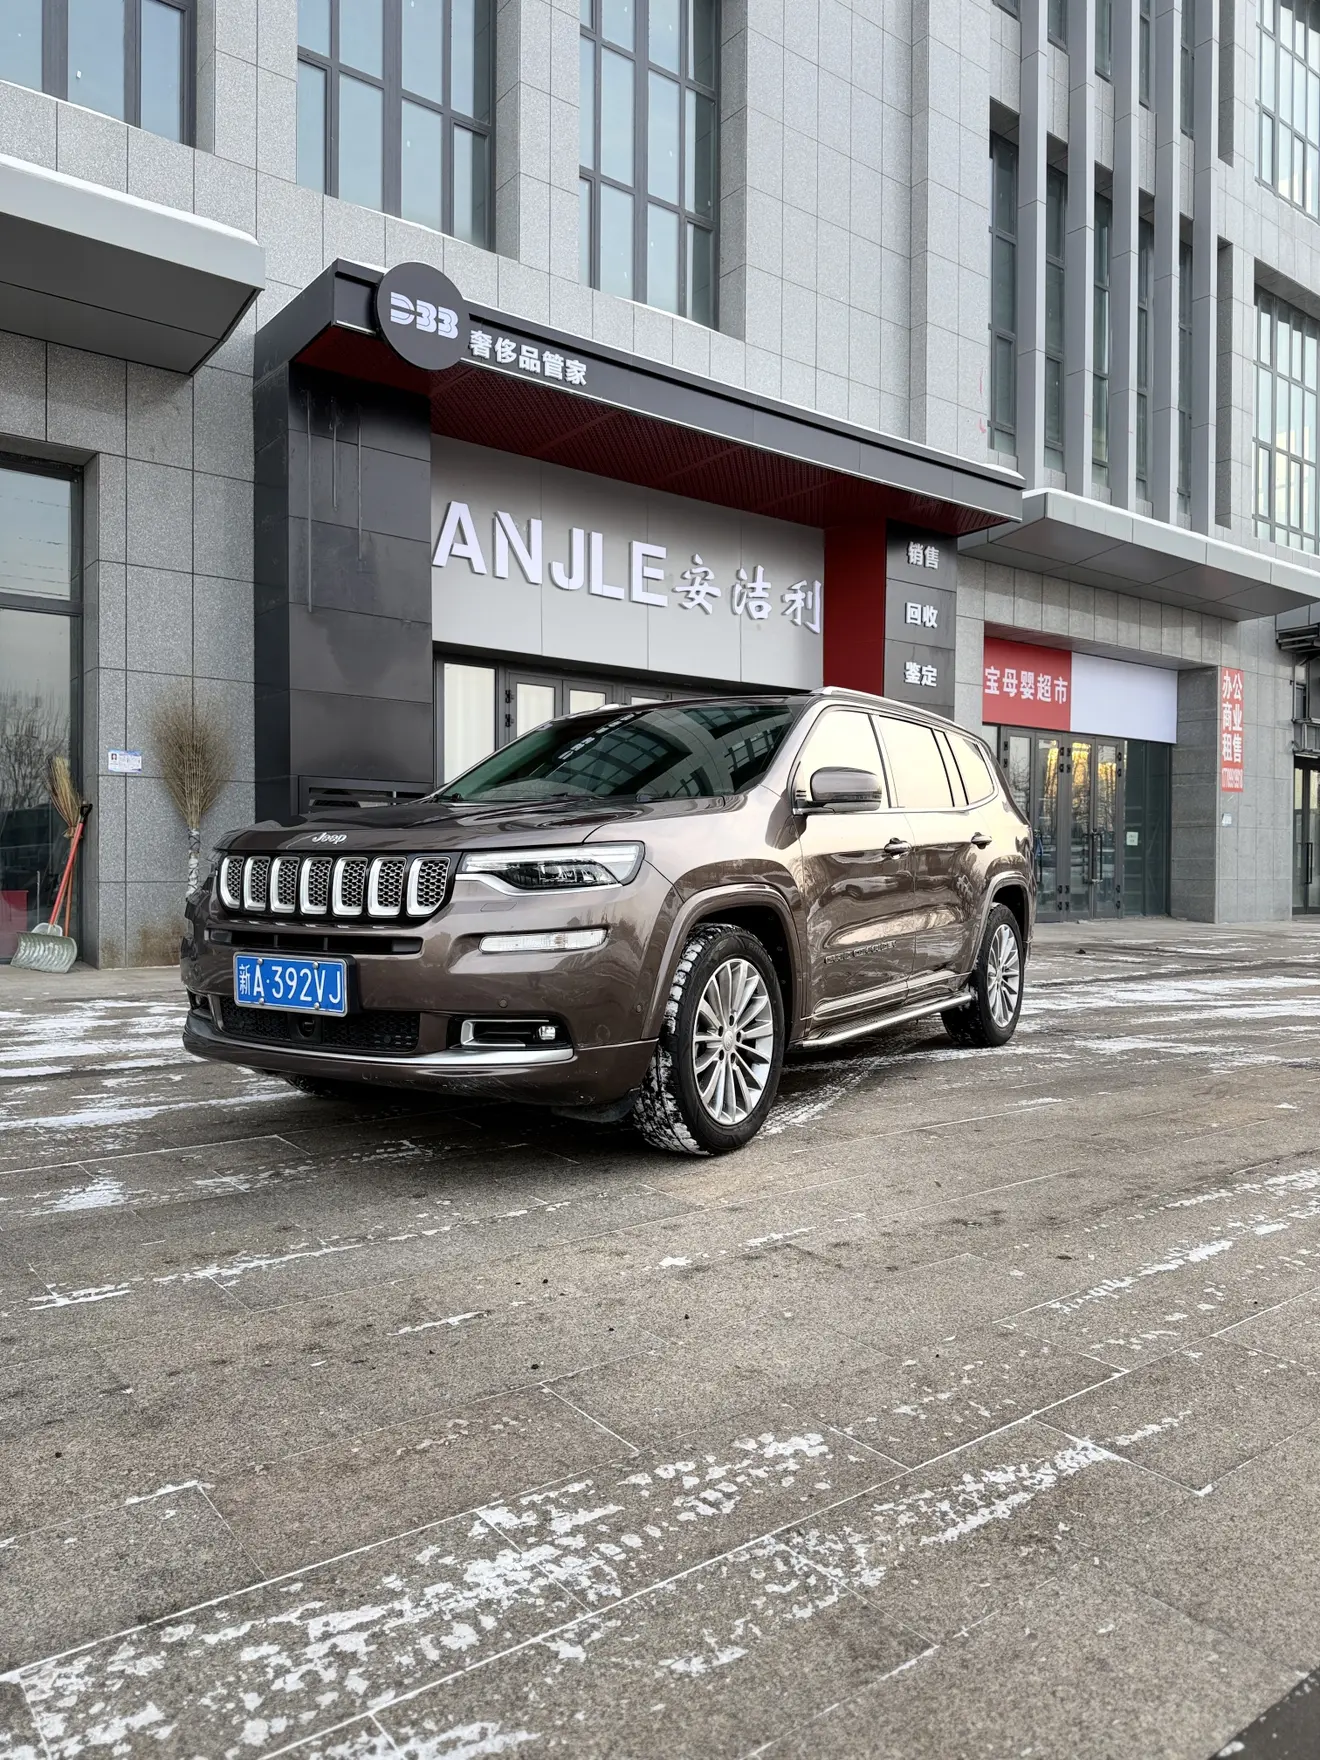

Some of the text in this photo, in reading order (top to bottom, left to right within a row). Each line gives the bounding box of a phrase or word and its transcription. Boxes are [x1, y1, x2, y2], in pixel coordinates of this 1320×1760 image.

[469, 330, 587, 386] 奢侈品管家
[432, 500, 669, 607] ANJLE
[908, 542, 939, 569] 销售
[672, 554, 823, 634] 安洁利
[905, 602, 938, 628] 回收
[905, 661, 937, 687] 鉴定
[985, 666, 1068, 704] 宝母婴超市
[1222, 670, 1242, 700] 办公
[1222, 702, 1242, 731] 商业
[312, 832, 347, 844] Jeep
